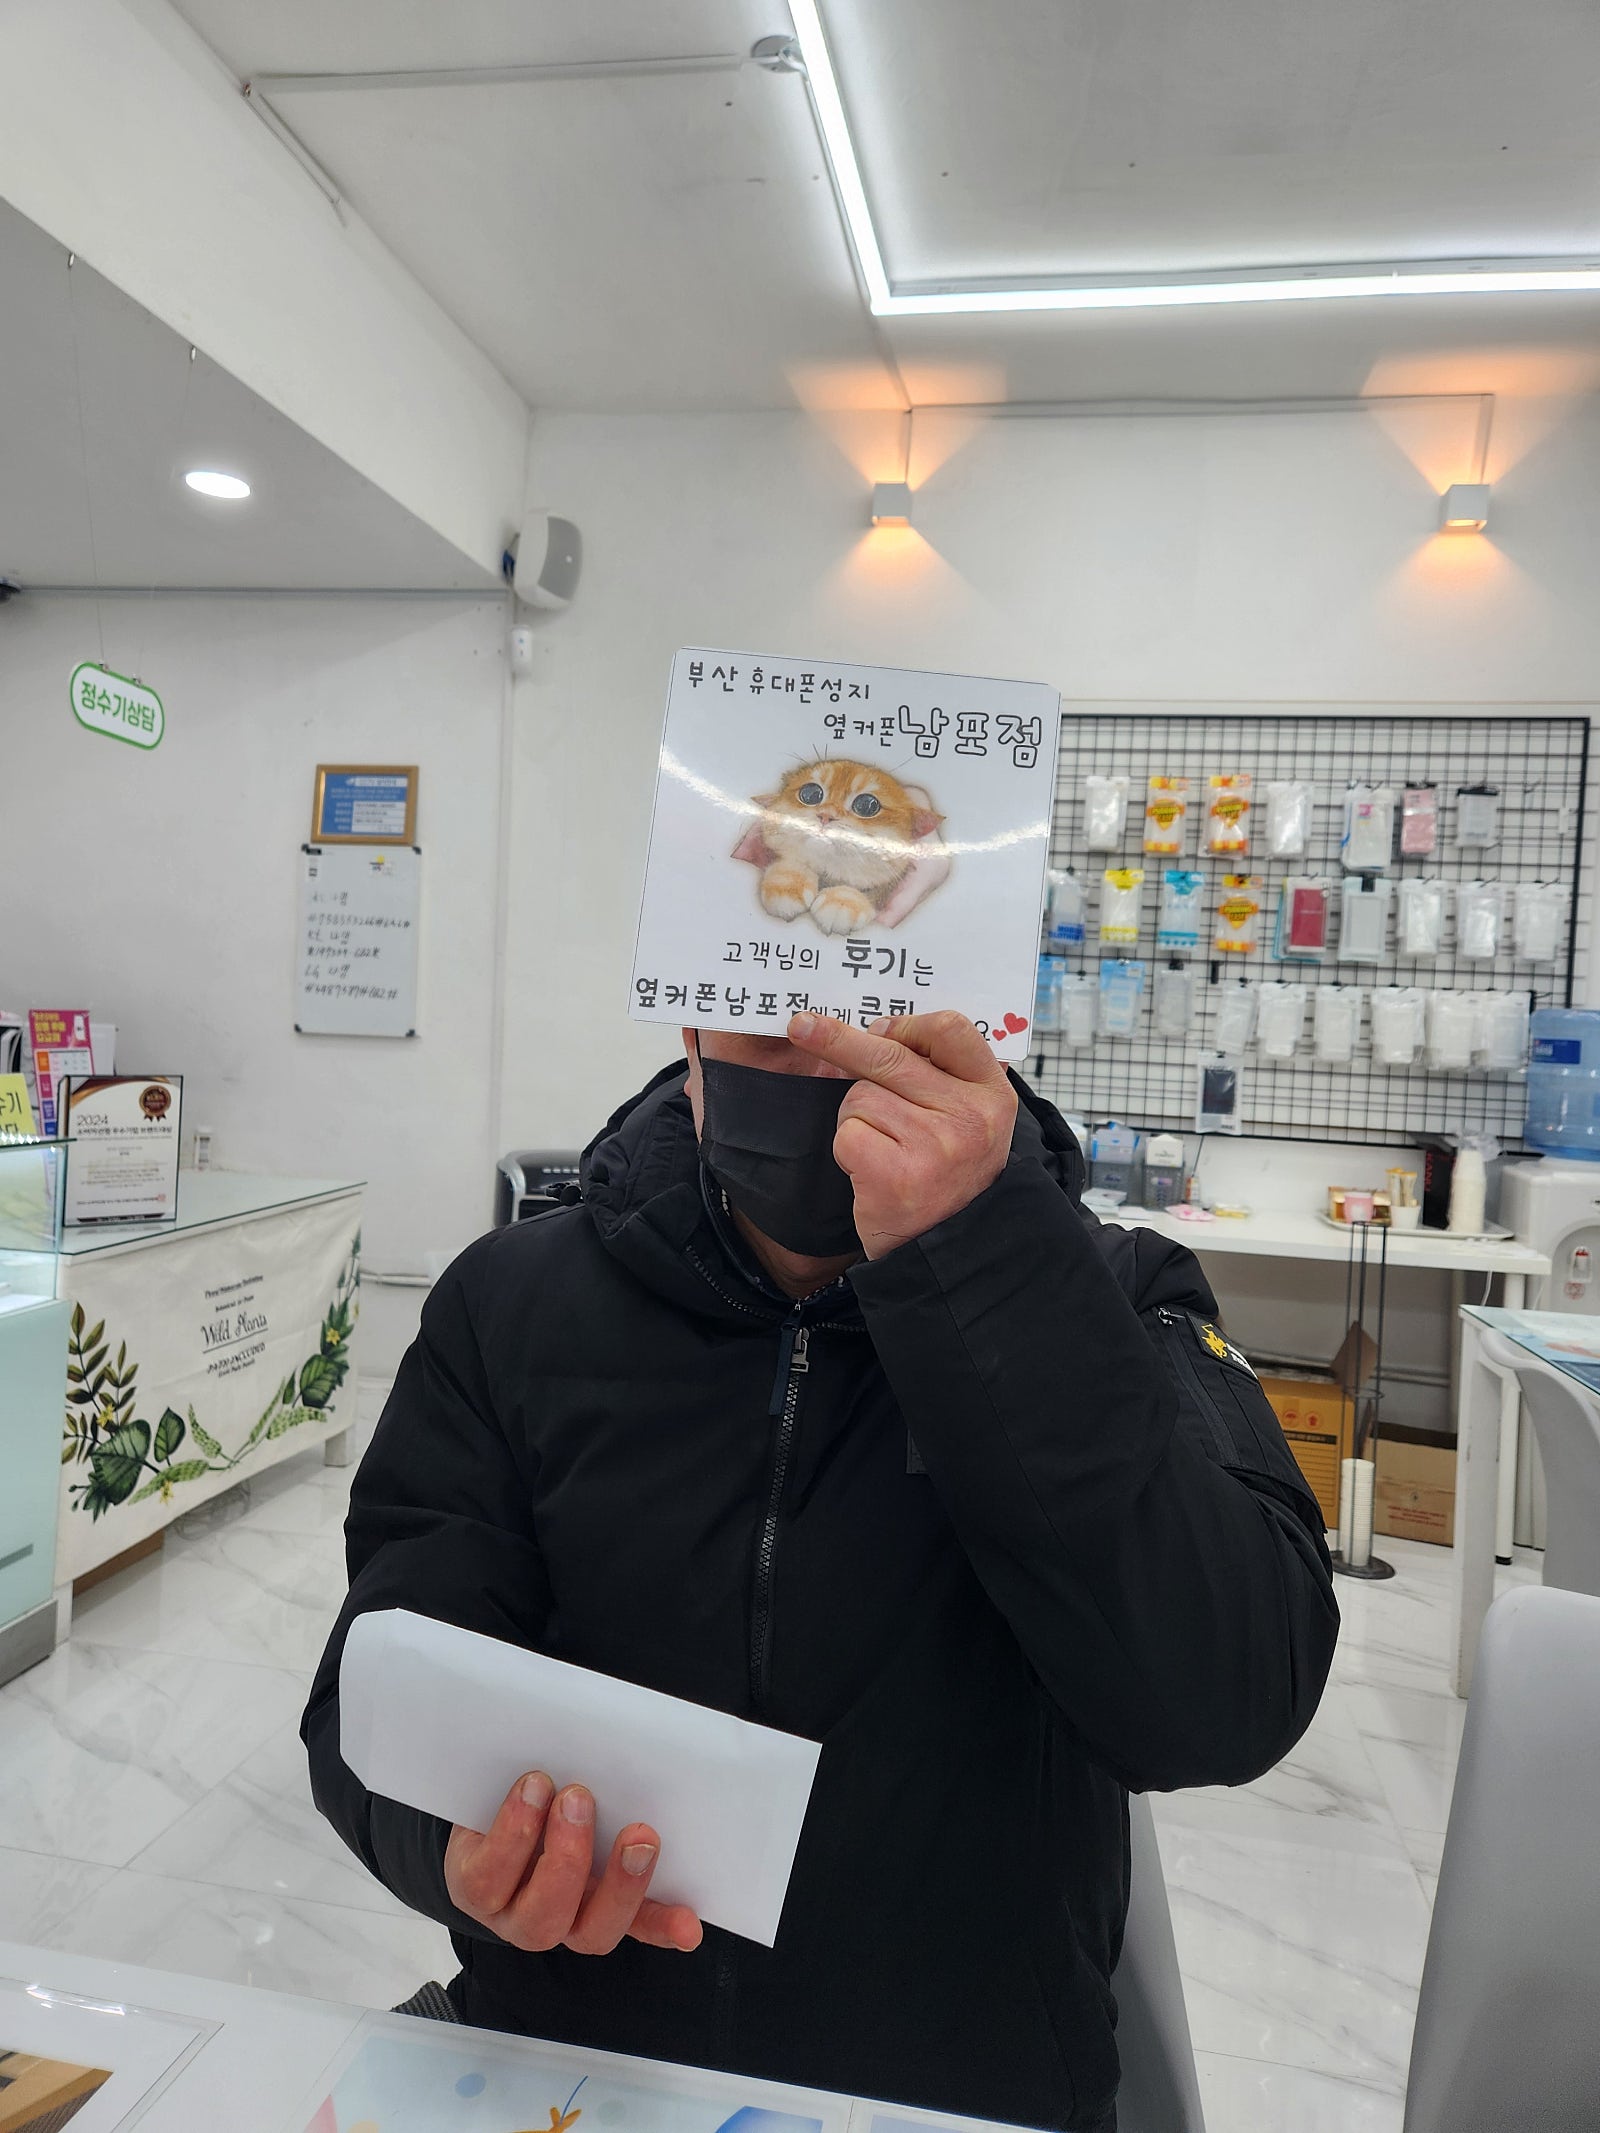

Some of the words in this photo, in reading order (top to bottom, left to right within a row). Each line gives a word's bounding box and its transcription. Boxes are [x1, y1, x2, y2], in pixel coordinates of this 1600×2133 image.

[688, 661, 739, 692] 부산
[749, 666, 871, 704] 휴대폰성지
[81, 681, 156, 733] 정수기상담
[722, 941, 821, 971] 고객님의
[841, 938, 935, 987] 후기는
[76, 1113, 109, 1126] 2024
[200, 1319, 231, 1346] Wild
